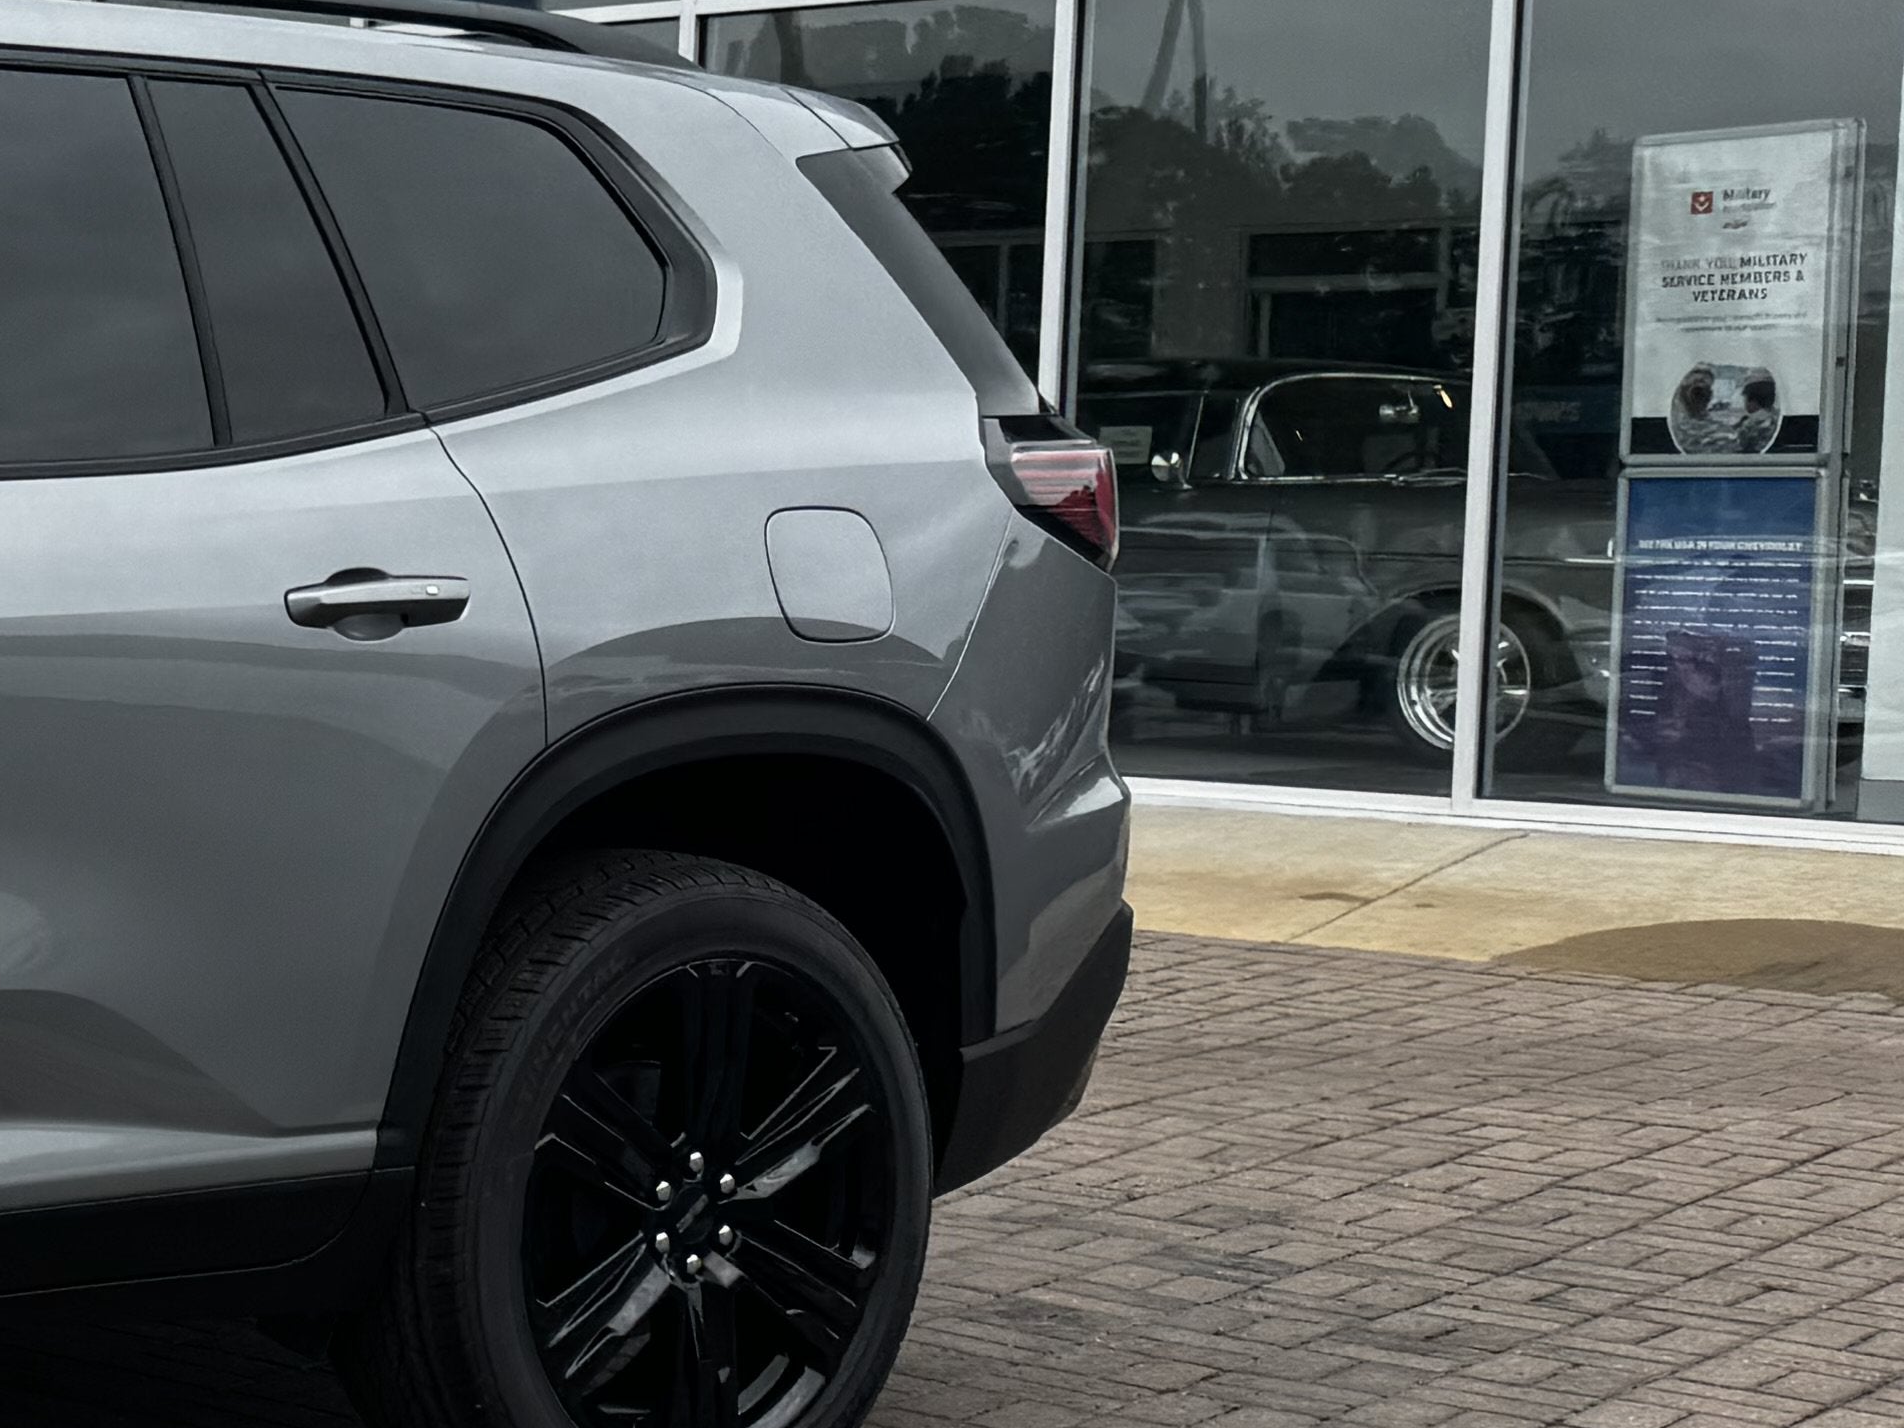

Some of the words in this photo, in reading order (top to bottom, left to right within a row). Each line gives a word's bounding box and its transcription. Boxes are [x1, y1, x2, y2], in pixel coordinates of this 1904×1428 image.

[1739, 252, 1808, 268] MILITARY
[1661, 273, 1715, 288] SERVICE
[1720, 270, 1791, 285] MEMBERS
[1692, 287, 1768, 303] VETERANS
